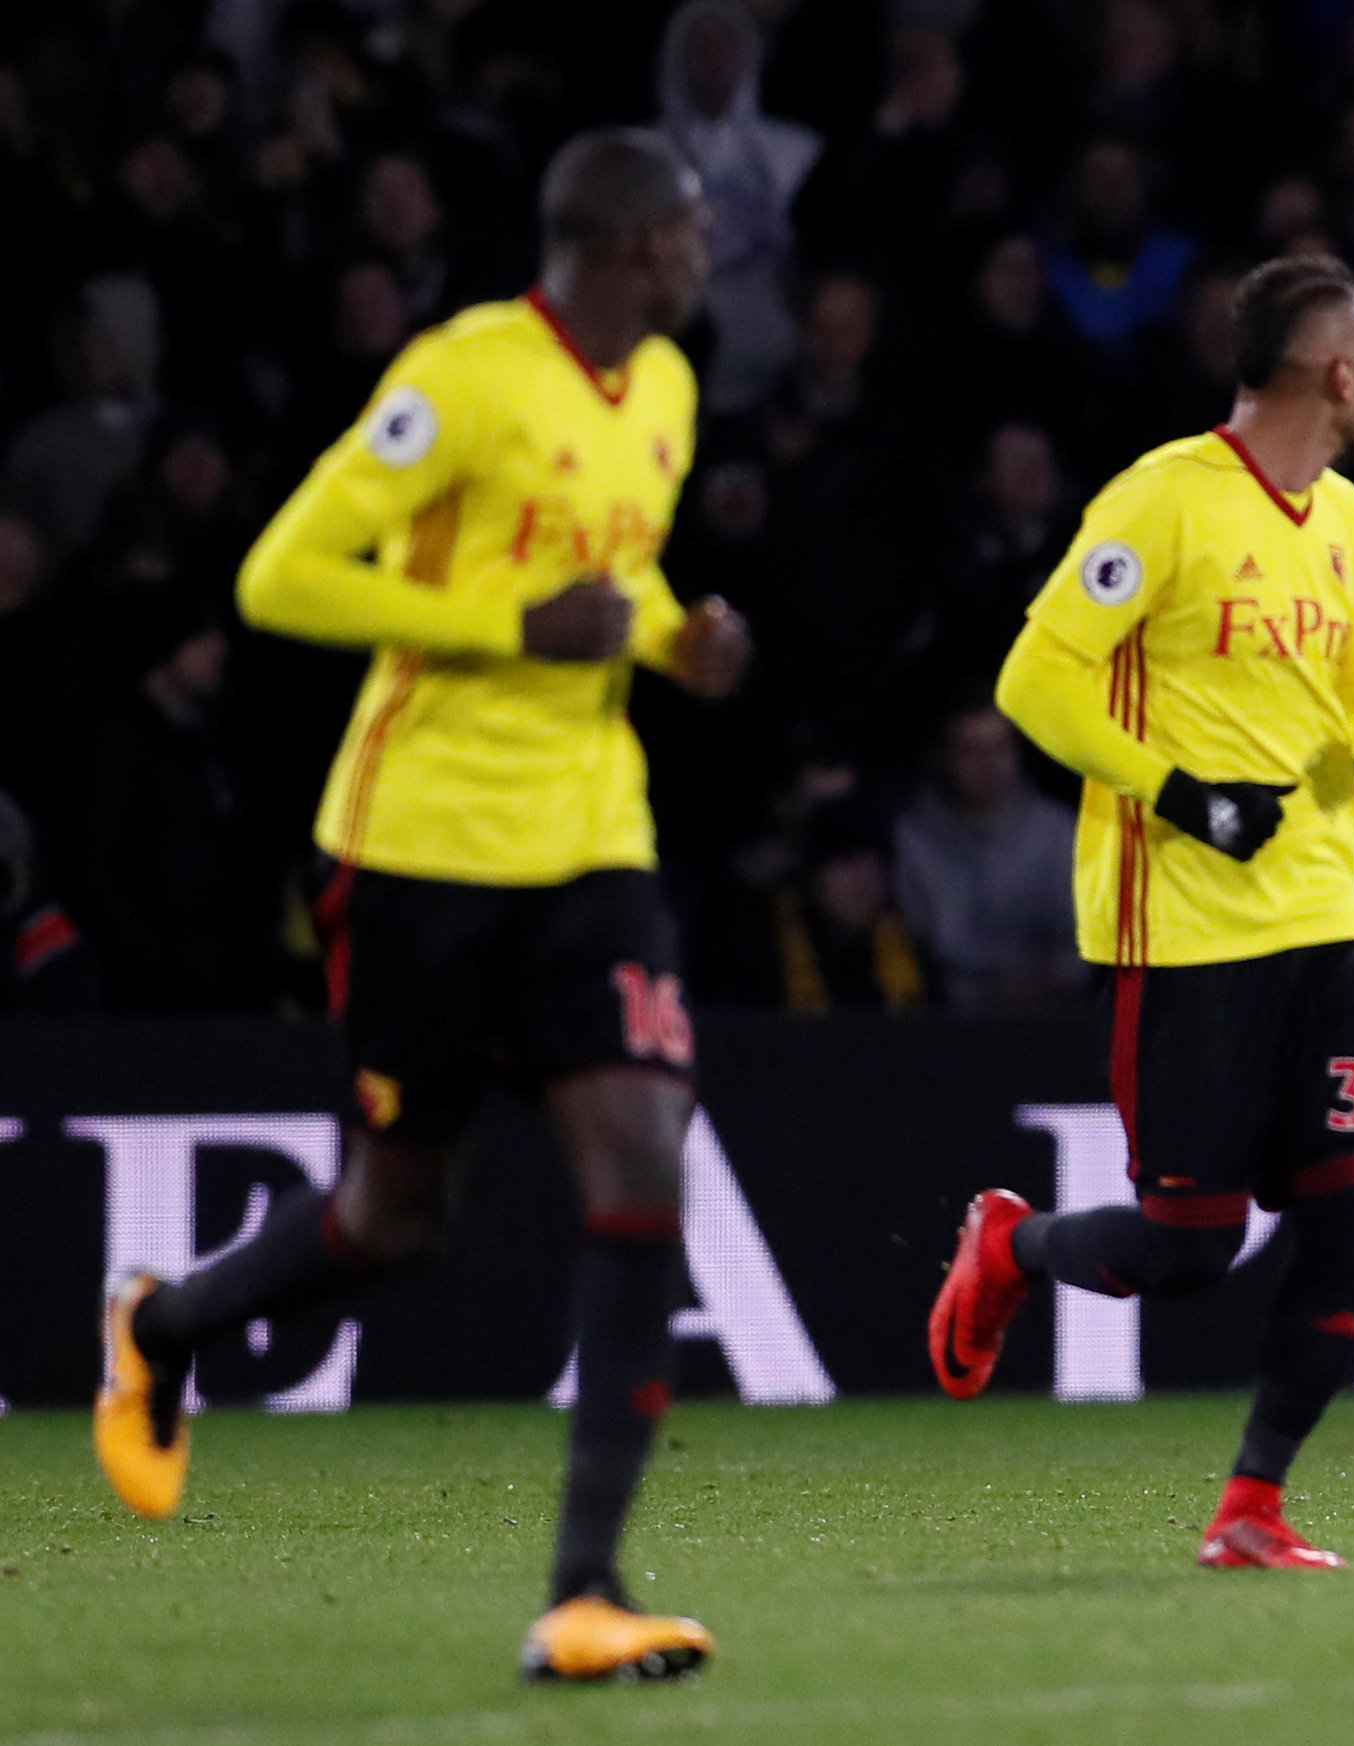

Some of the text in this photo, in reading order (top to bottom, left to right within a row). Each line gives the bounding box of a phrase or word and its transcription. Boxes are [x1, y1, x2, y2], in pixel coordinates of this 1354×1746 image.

[611, 962, 694, 1066] 16
[0, 1112, 362, 1414] E
[548, 1102, 838, 1409] A
